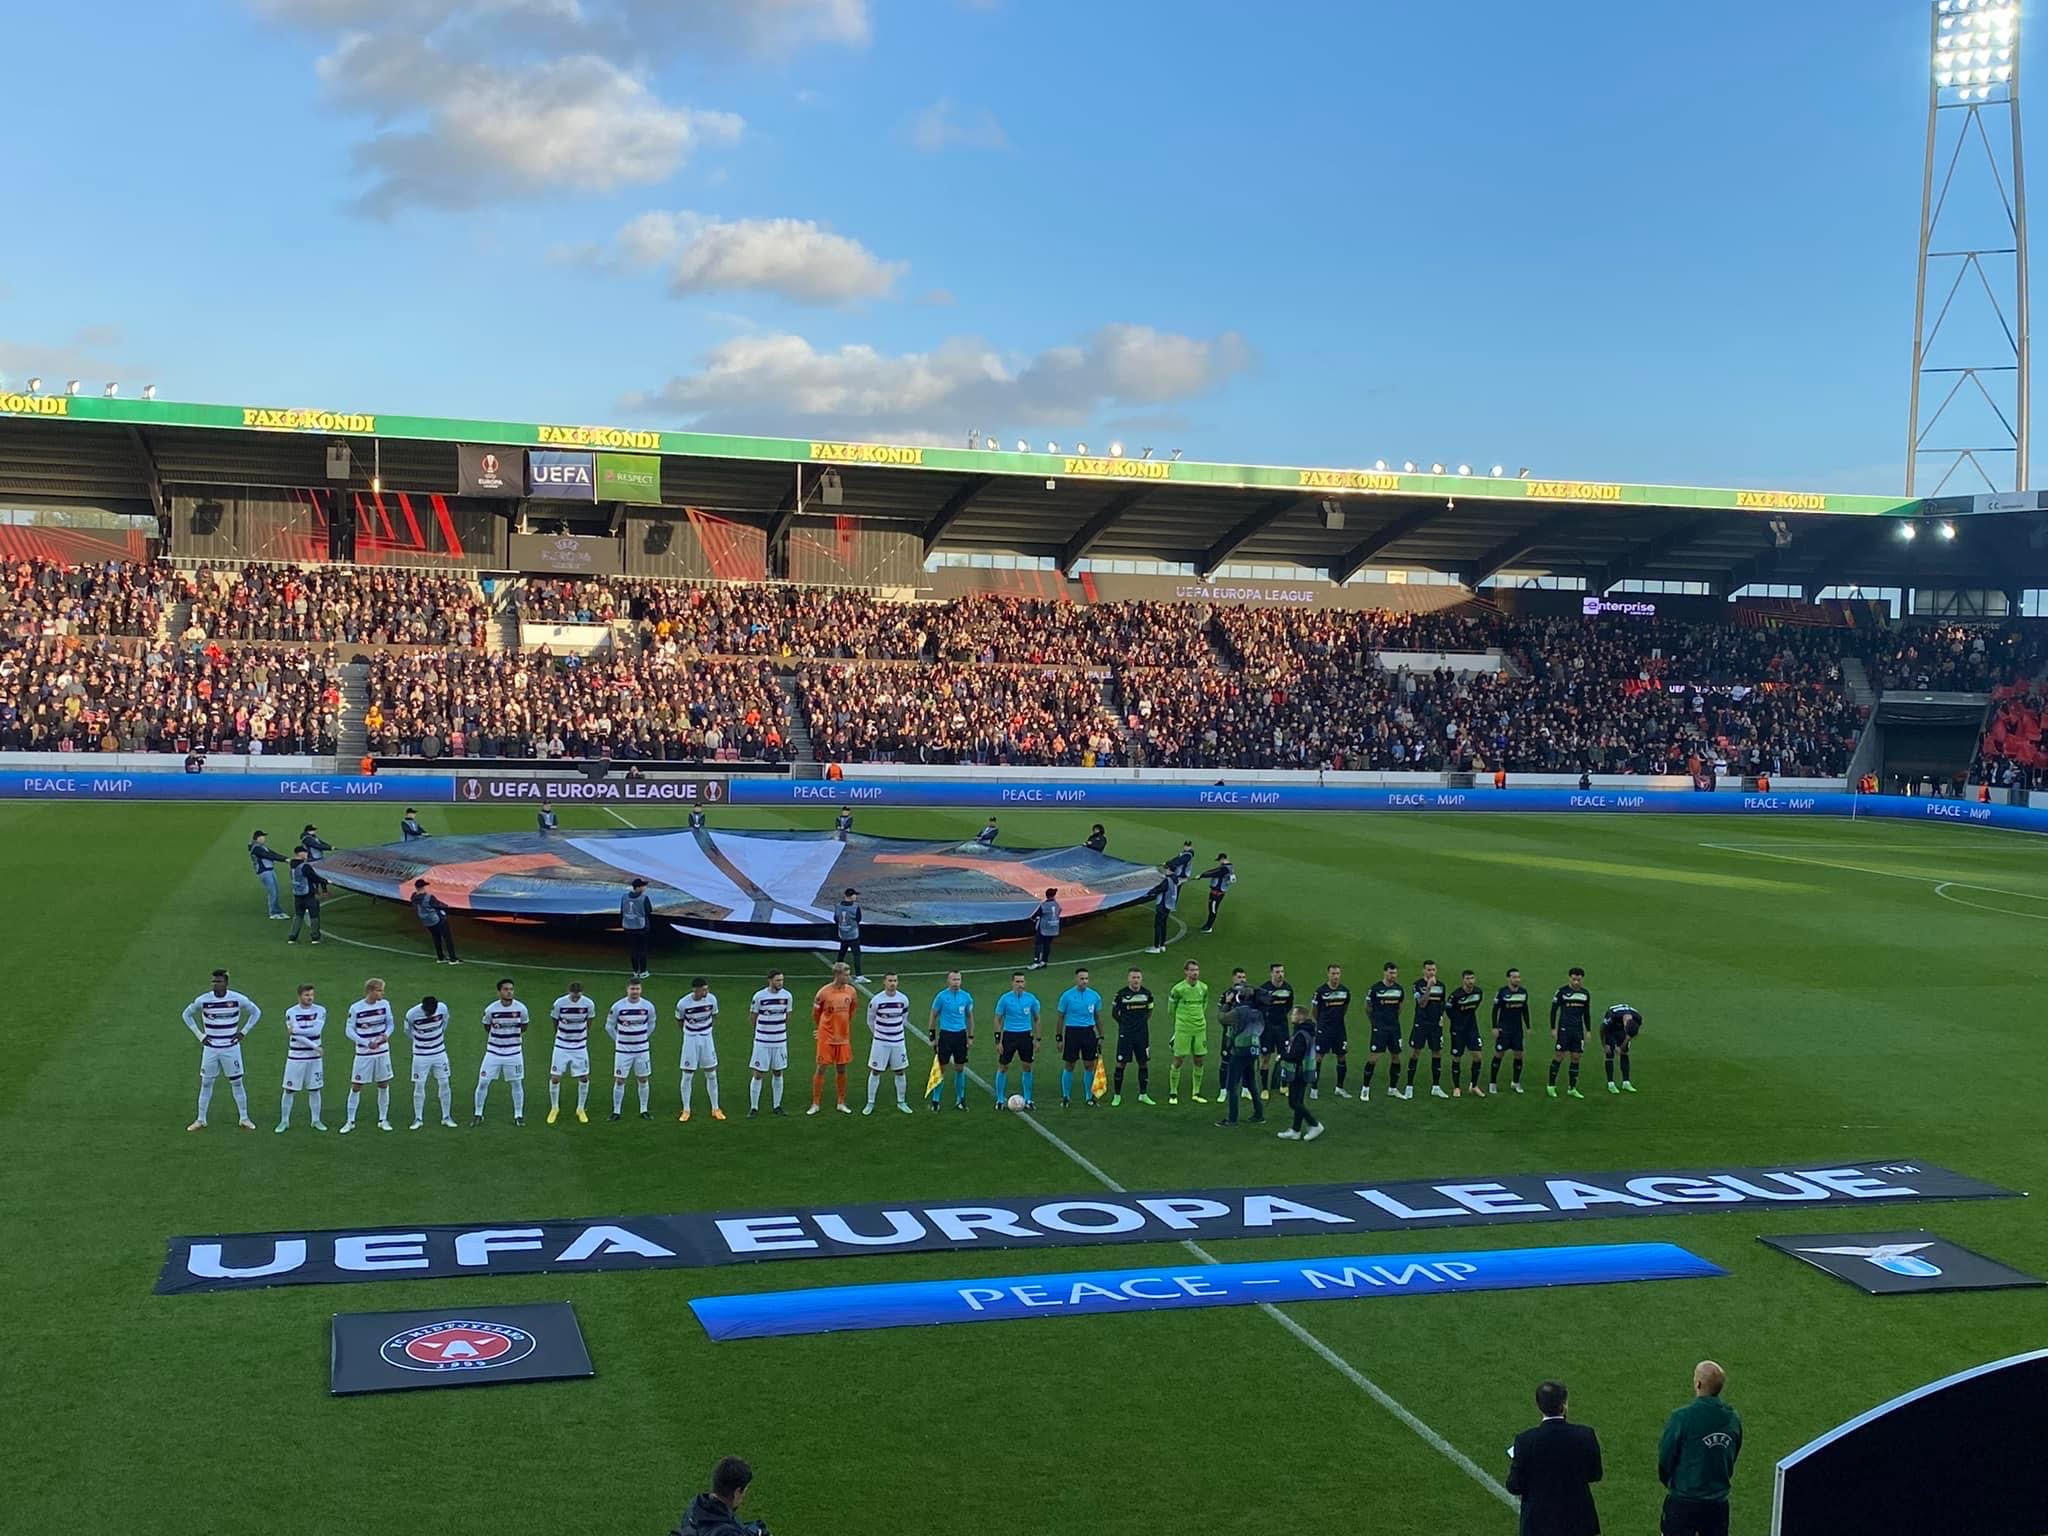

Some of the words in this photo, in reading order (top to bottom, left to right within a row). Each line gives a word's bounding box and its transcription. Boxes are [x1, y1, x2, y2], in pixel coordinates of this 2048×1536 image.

[243, 409, 299, 427] FAXE
[303, 411, 375, 432] KONDI
[538, 426, 590, 444] FAXE
[594, 429, 660, 449] KONDI
[810, 443, 857, 460] FAXE
[862, 445, 923, 464] KONDI
[533, 466, 589, 483] UEFA
[1064, 459, 1108, 475] FAXE
[1113, 461, 1170, 478] KONDI
[616, 473, 654, 484] RESPECT
[1176, 586, 1210, 598] UEFA
[1212, 588, 1262, 600] EUROPA
[1264, 590, 1314, 602] LEAGUE
[1588, 601, 1656, 614] enterprise
[24, 778, 76, 792] PEACE
[93, 779, 132, 793] МИР
[280, 780, 330, 794] PEACE
[345, 781, 384, 795] МИР
[490, 782, 538, 797] UEFA
[546, 783, 617, 798] EUROPA
[625, 784, 697, 799] LEAGUE
[793, 786, 836, 799] PEACE
[850, 787, 883, 799] МИР
[1002, 788, 1043, 801] PEACE
[1055, 789, 1087, 802] МИР
[1200, 791, 1238, 803] PEACE
[1250, 792, 1280, 804] МИР
[1437, 794, 1466, 806] МИР
[1570, 795, 1606, 807] PEACE
[1617, 796, 1645, 808] МИР
[1744, 797, 1778, 809] PEACE
[1789, 798, 1815, 810] МИР
[1926, 803, 1961, 817] PEACE
[1970, 807, 1991, 821] МИР
[187, 1225, 677, 1278] UEFA
[713, 1195, 1356, 1253] EUROPA
[1354, 1168, 1920, 1219] LEAGUE
[958, 1275, 1228, 1311] PEACE
[1302, 1261, 1478, 1290] МИР
[1704, 1434, 1731, 1448] UEFA
